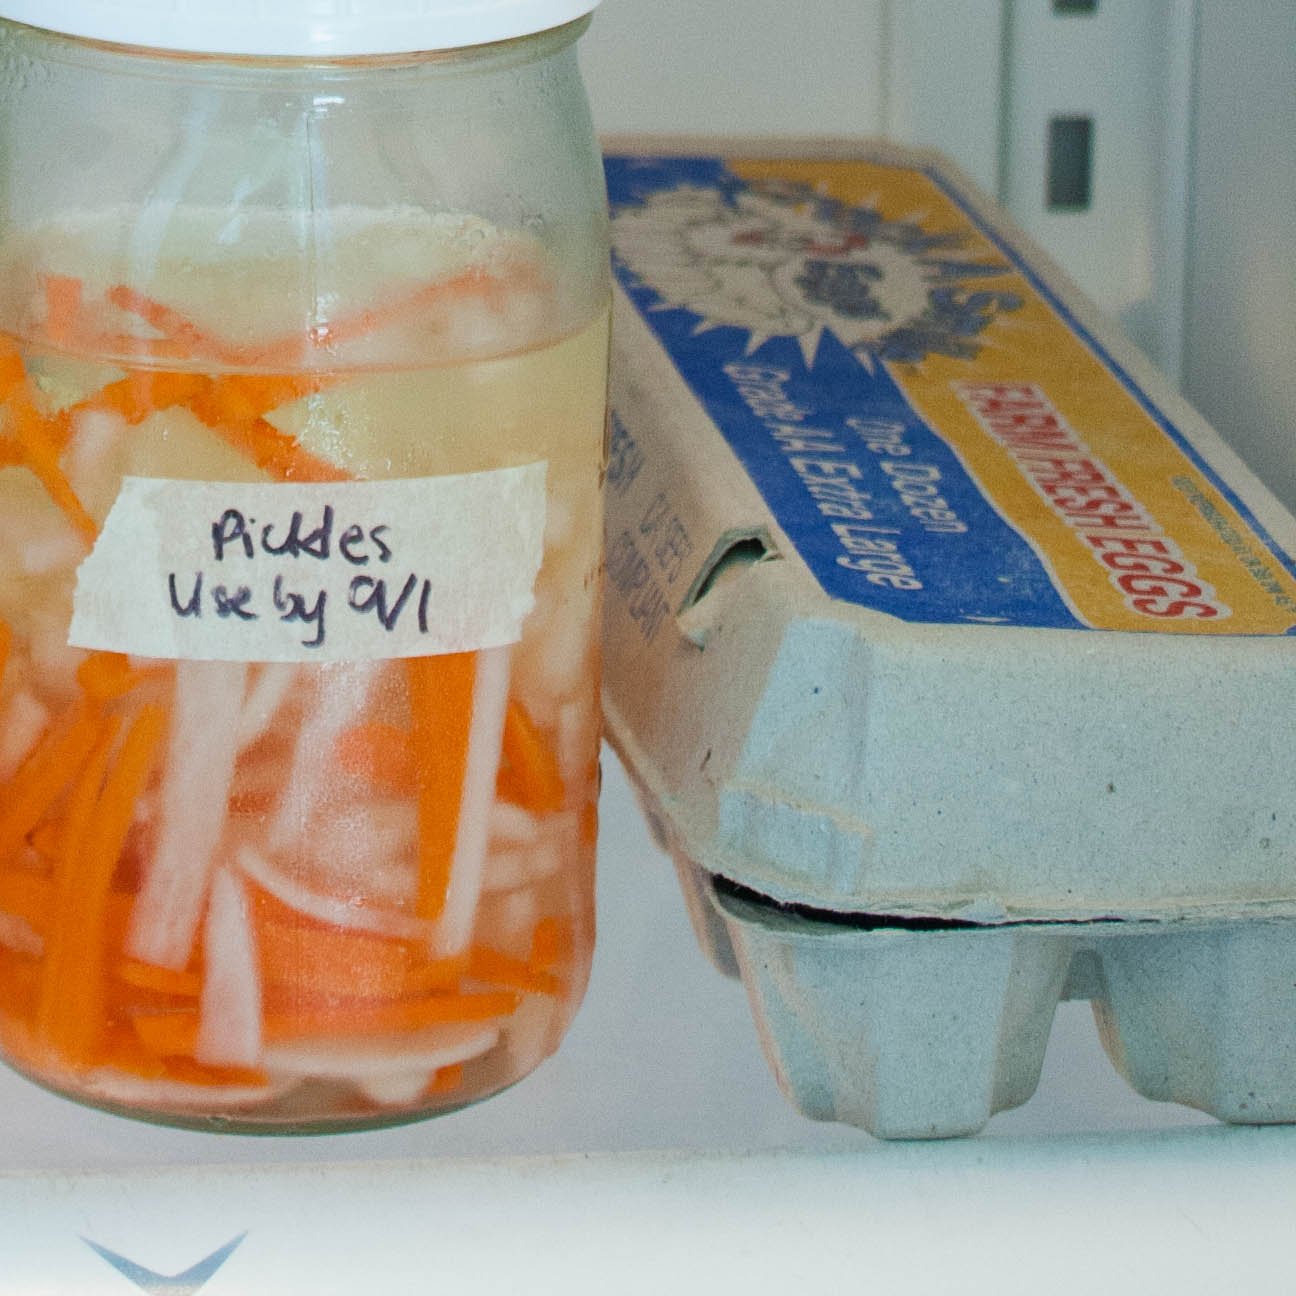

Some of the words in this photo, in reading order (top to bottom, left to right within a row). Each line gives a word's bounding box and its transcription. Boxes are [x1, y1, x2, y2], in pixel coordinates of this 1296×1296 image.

[789, 458, 874, 520] Extra
[879, 460, 968, 534] Dozen
[830, 522, 923, 590] Large
[1014, 456, 1151, 531] FRESH
[1085, 534, 1219, 618] EGGS
[168, 571, 259, 618] Use
[273, 574, 329, 648] by
[349, 571, 433, 634] 9/1
